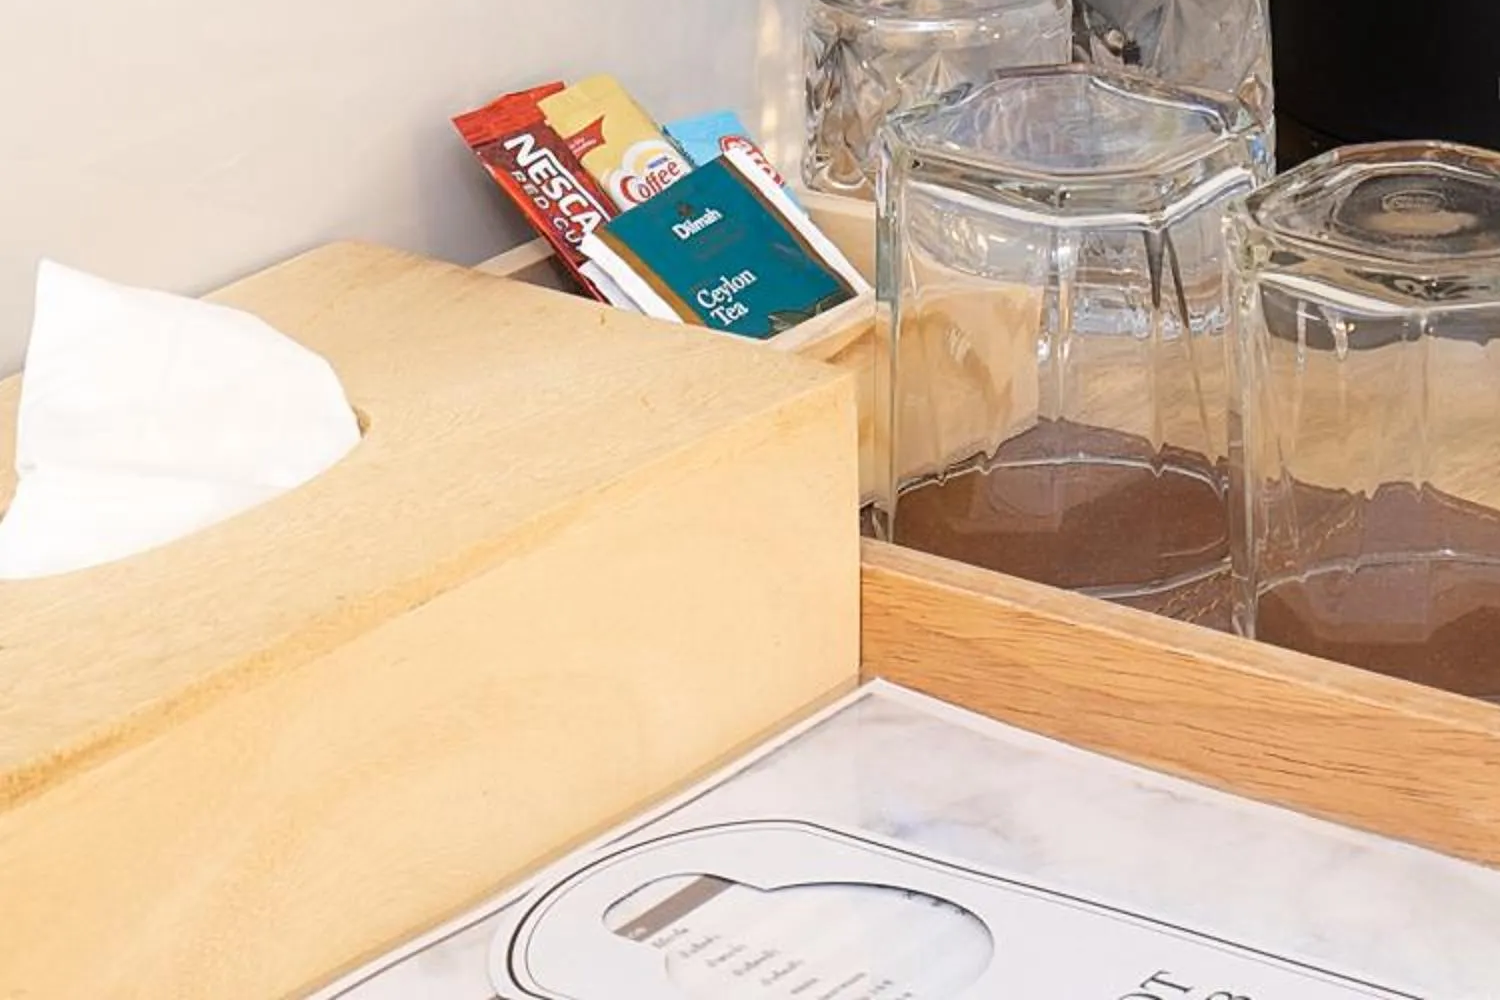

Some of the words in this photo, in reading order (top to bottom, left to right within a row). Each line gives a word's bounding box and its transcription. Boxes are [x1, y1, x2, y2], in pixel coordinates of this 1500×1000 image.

[672, 208, 723, 240] Dilmah
[696, 269, 758, 309] Ceylon
[710, 301, 750, 327] Tea
